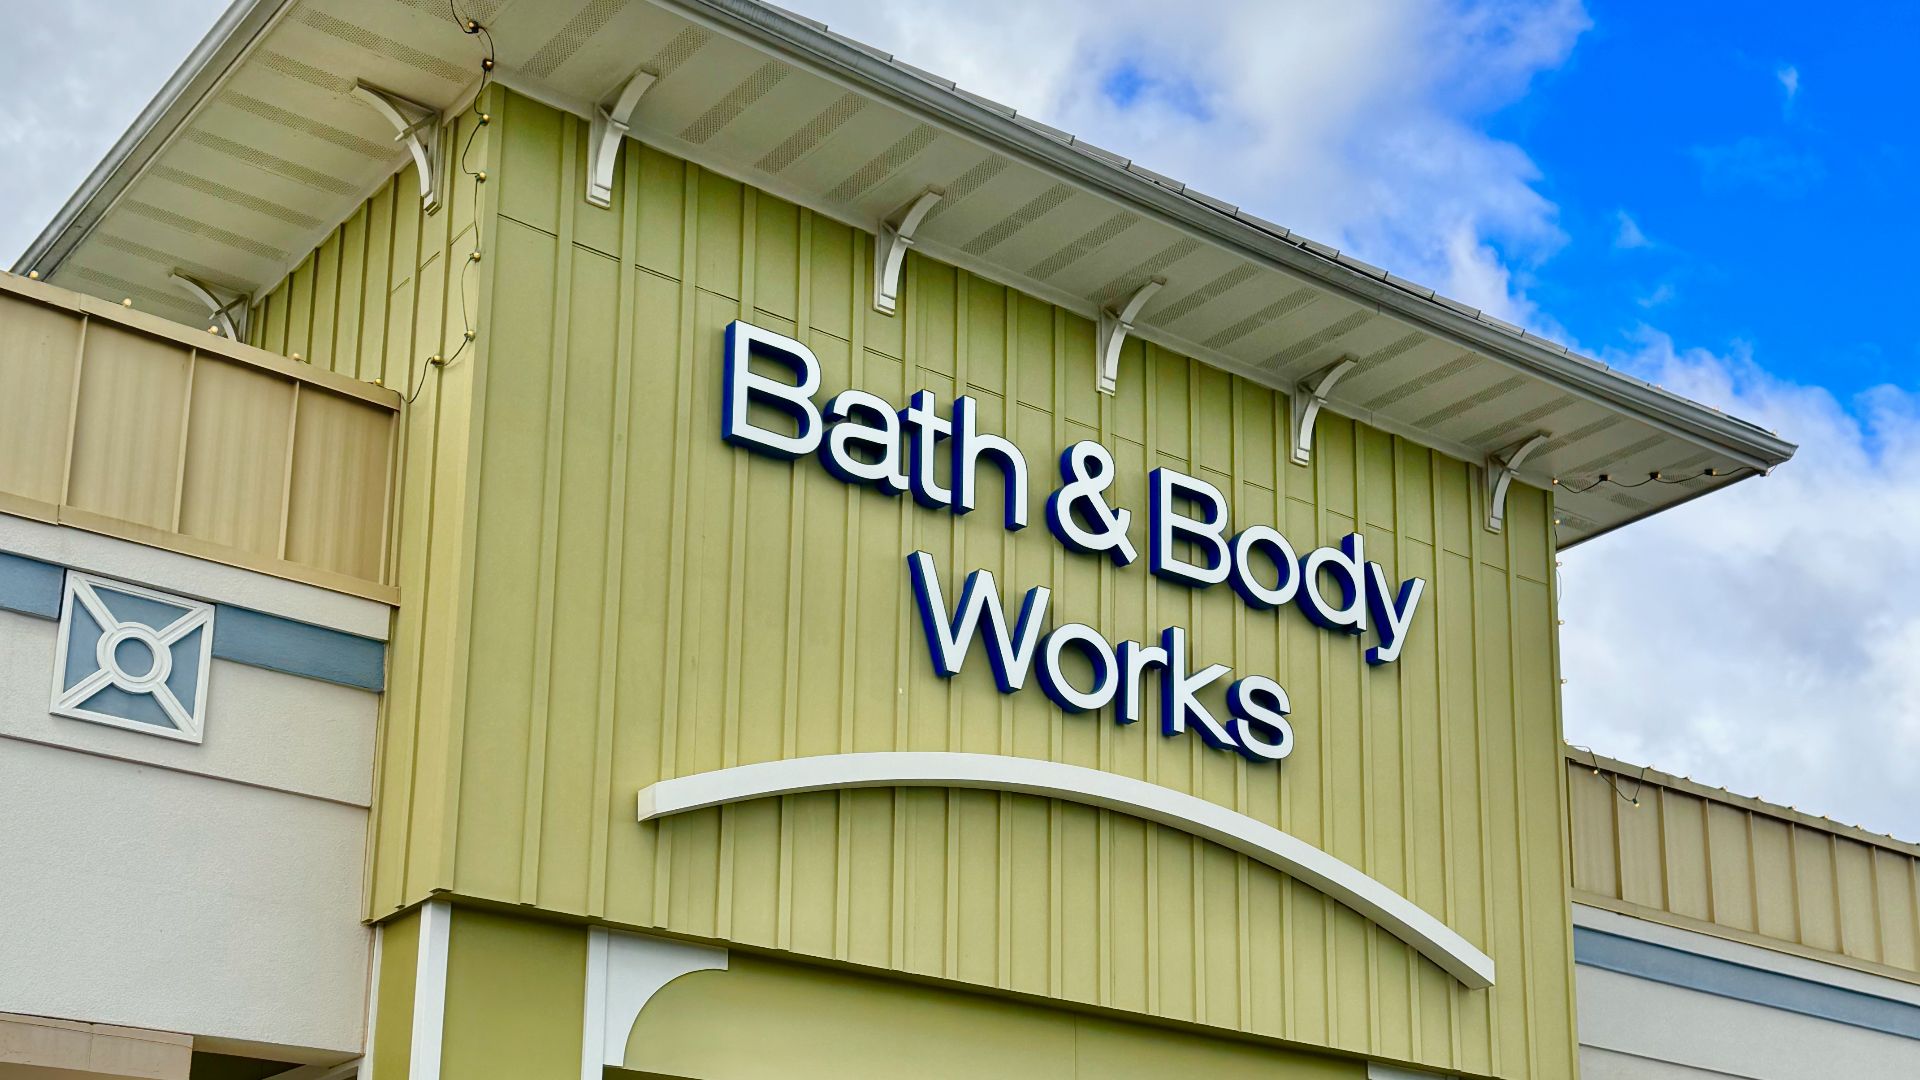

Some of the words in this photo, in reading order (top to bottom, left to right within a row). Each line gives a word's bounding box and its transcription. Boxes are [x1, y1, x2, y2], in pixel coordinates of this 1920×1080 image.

[722, 319, 1028, 531] Bath
[1047, 439, 1138, 567] &
[1150, 467, 1426, 666] Body
[908, 550, 1294, 762] Works
